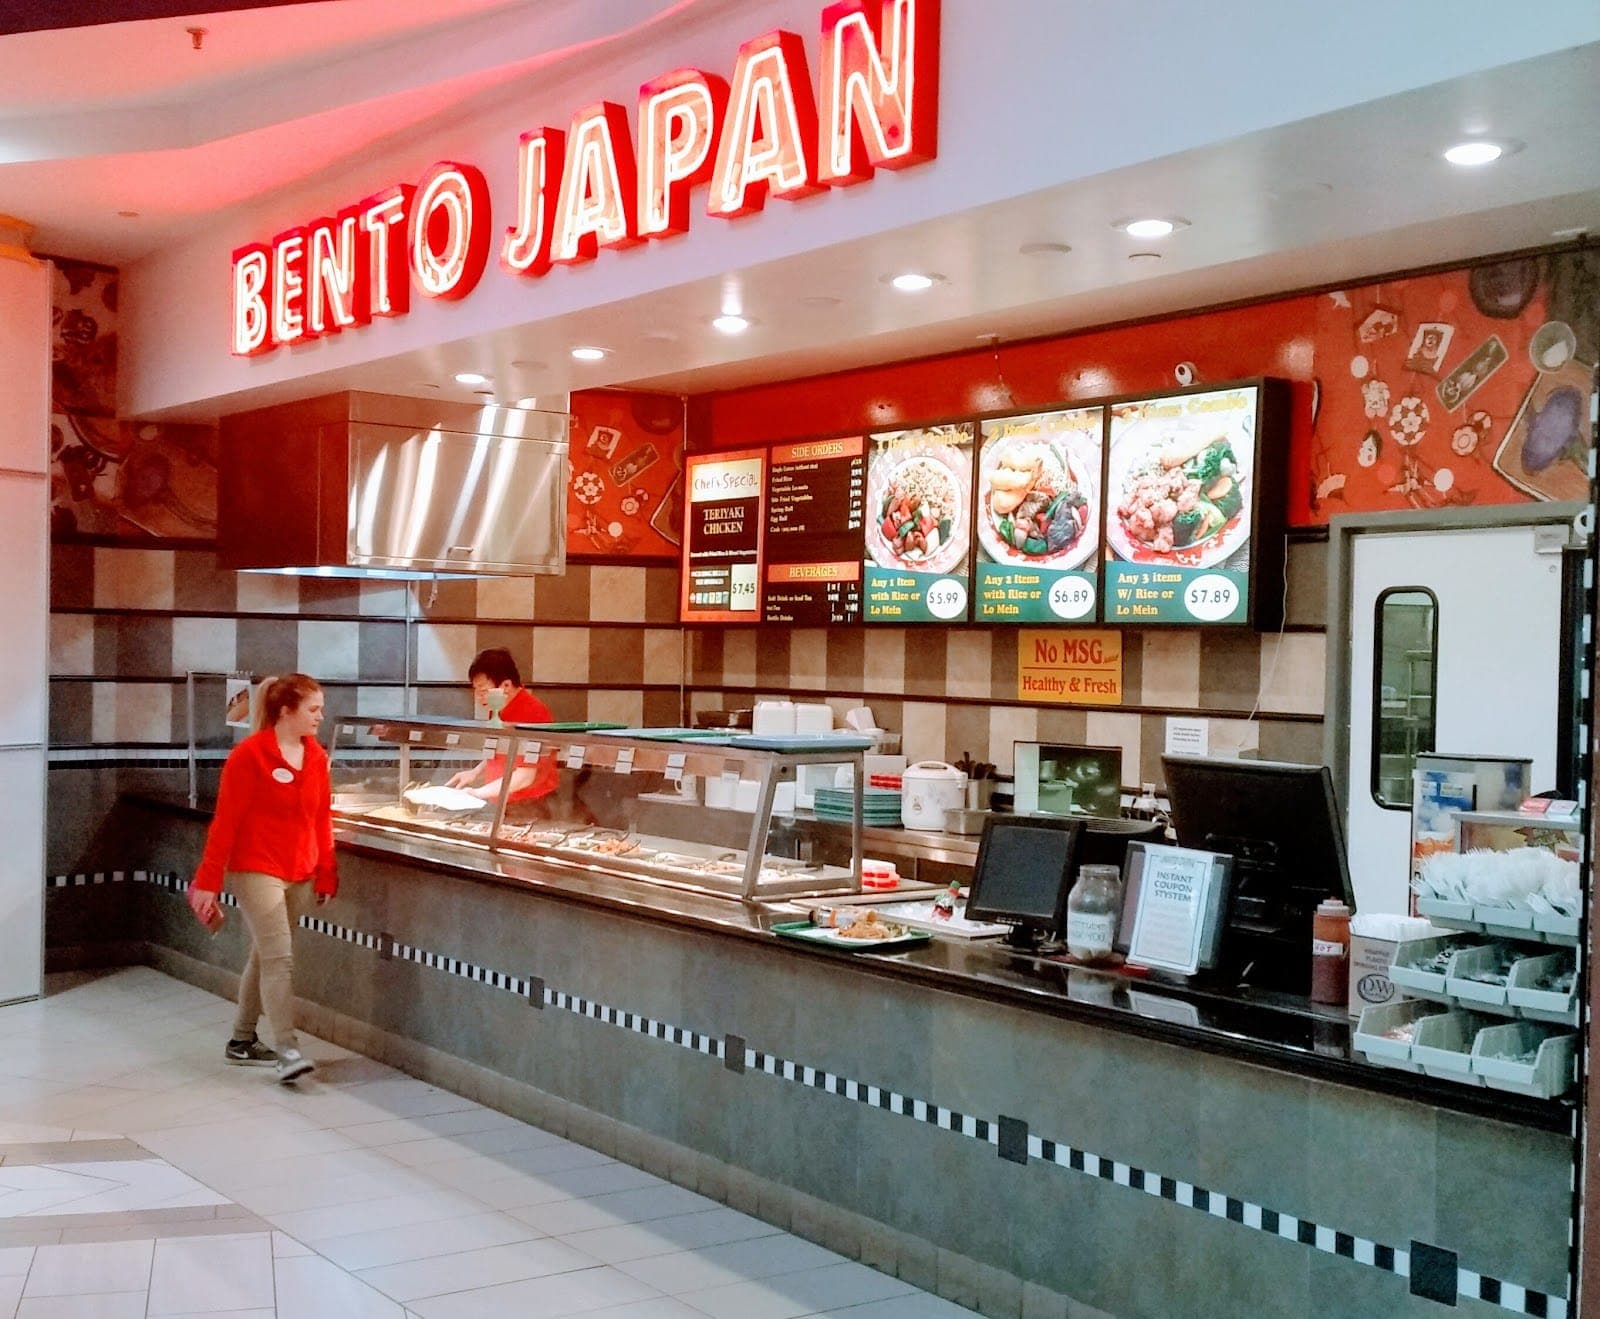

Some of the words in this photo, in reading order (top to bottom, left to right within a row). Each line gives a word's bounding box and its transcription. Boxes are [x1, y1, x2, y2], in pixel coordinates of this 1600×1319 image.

[231, 161, 491, 356] BENTO
[502, 0, 939, 277] JAPAN
[791, 446, 810, 458] SIDE
[811, 442, 844, 457] ORDERS
[703, 507, 745, 521] TERIYAKI
[703, 521, 744, 535] CHICKEN
[789, 566, 838, 578] BEVERAGES
[871, 577, 888, 588] Any
[889, 578, 895, 587] 1
[984, 575, 1003, 587] Any
[1005, 575, 1012, 585] 2
[1118, 573, 1138, 585] Any
[1141, 573, 1149, 584] 3
[870, 591, 890, 601] with
[891, 591, 909, 601] Rice
[910, 592, 920, 601] or
[929, 592, 958, 604] $5.99
[983, 590, 1006, 600] with
[1007, 589, 1028, 600] Rice
[1030, 591, 1041, 600] or
[1054, 590, 1088, 604] $6.89
[1117, 588, 1132, 601] W/
[1135, 588, 1159, 599] Rice
[1161, 589, 1175, 599] or
[1191, 589, 1231, 604] $7.89
[870, 605, 880, 615] Lo
[882, 604, 901, 615] Mein
[983, 604, 994, 614] Lo
[995, 604, 1019, 614] Mein
[1116, 604, 1130, 615] Lo
[1132, 604, 1158, 615] Mein
[1035, 639, 1057, 664] No
[1063, 639, 1103, 664] MSG
[1022, 675, 1066, 695] Healthy
[1069, 676, 1081, 692] &
[1083, 677, 1117, 694] Fresh
[1156, 871, 1193, 884] INSTANT
[1154, 880, 1193, 892] COUPON
[1154, 890, 1192, 902] STYSTEM
